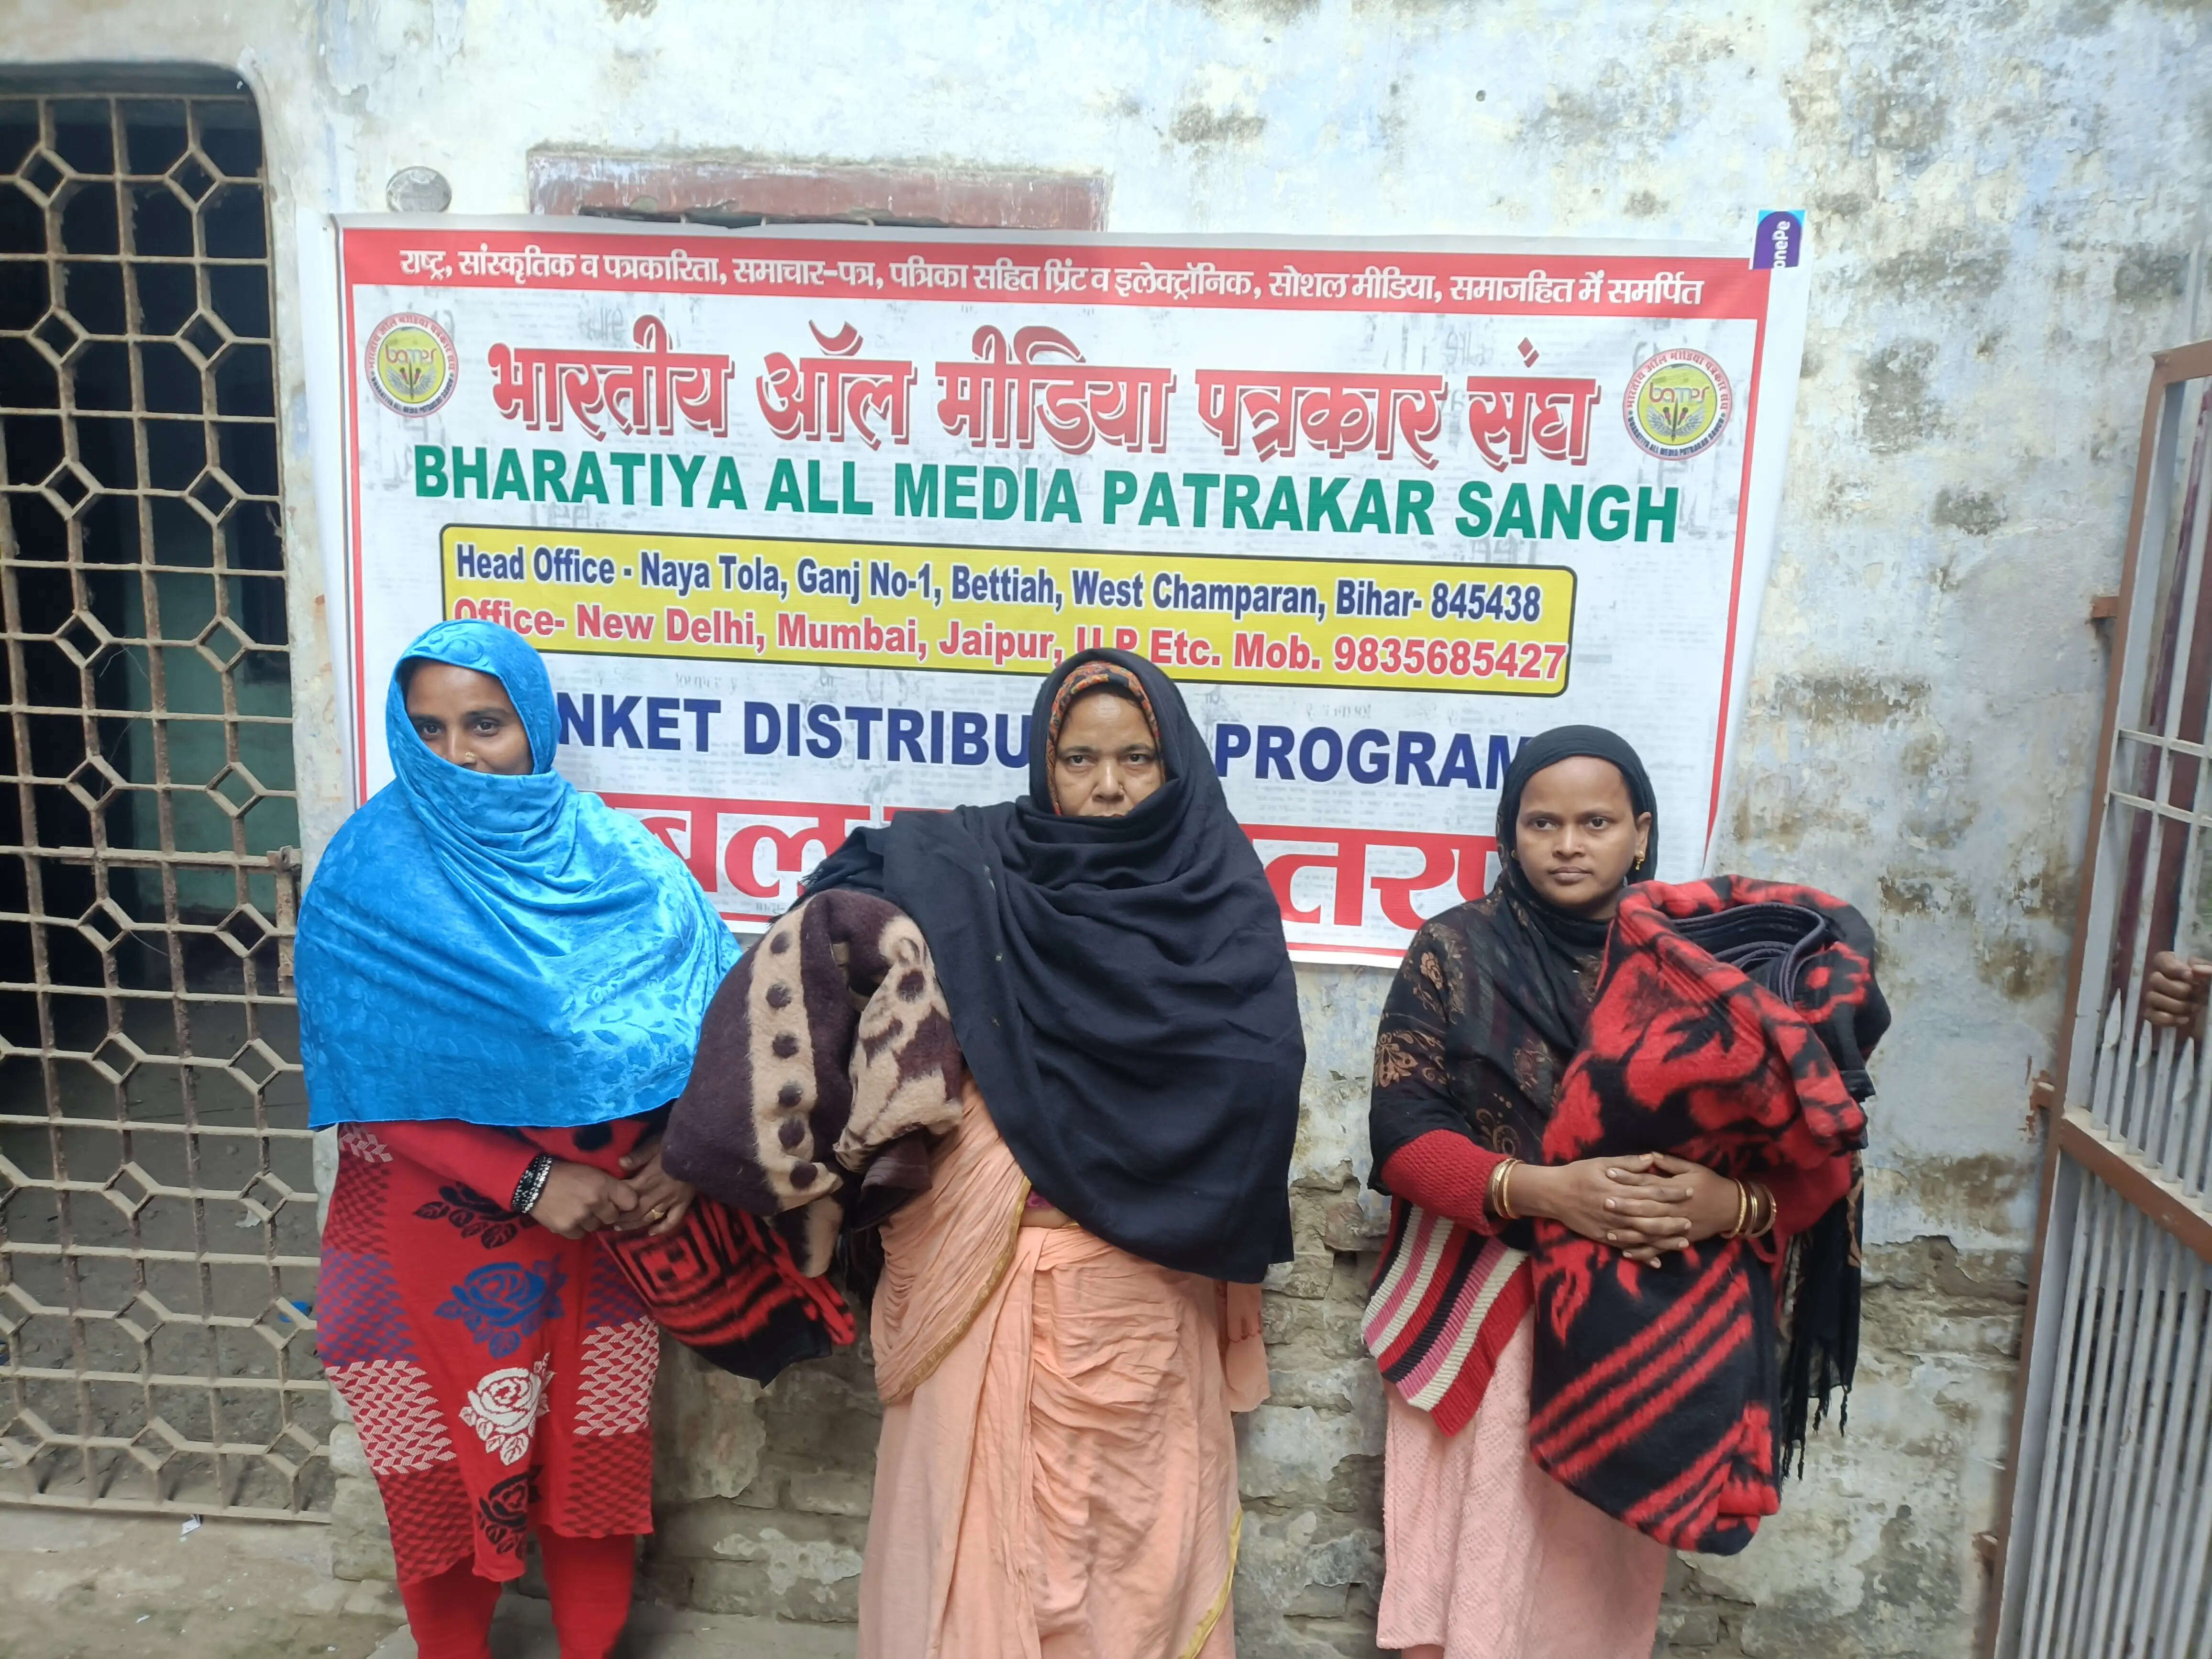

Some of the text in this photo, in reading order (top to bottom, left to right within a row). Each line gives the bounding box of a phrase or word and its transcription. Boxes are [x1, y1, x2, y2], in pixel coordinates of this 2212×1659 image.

[400, 243, 1704, 304] राष्ट्र, सांस्कृतिक व पत्रकारिता, समाचार-पत्र, पत्रिका सहित प्रिंट व इलेक्ट्रॉनिक, सोशल मीडिया, समाजहित में समर्पित
[488, 314, 1601, 472] भारतीय ऑल मीडिया पत्रकार संघ
[415, 446, 1678, 543] BHARATIYA ALL MEDIA PATRAKAR SANGH
[458, 544, 523, 579] Head
[534, 548, 614, 583] Office
[642, 553, 709, 596] Naya
[719, 556, 786, 597] Tola,
[798, 559, 859, 604] Ganj
[871, 563, 940, 603] No-1,
[953, 566, 1062, 608] Bettiah,
[1073, 571, 1143, 607] West
[1154, 574, 1325, 619] Champaran,
[1337, 580, 1421, 616] Bihar-
[1432, 584, 1540, 621] 845438
[455, 599, 564, 635] Office-
[578, 606, 653, 639] New
[668, 610, 764, 652] Delhi,
[779, 615, 926, 660] Mumbai,
[940, 623, 1062, 666] Jaipur,
[1151, 630, 1219, 665] Etc.
[1235, 634, 1319, 669] Mob.
[1336, 637, 1566, 678] 9835685427
[558, 693, 720, 752] NKET
[745, 702, 1032, 768] DISTRIBU
